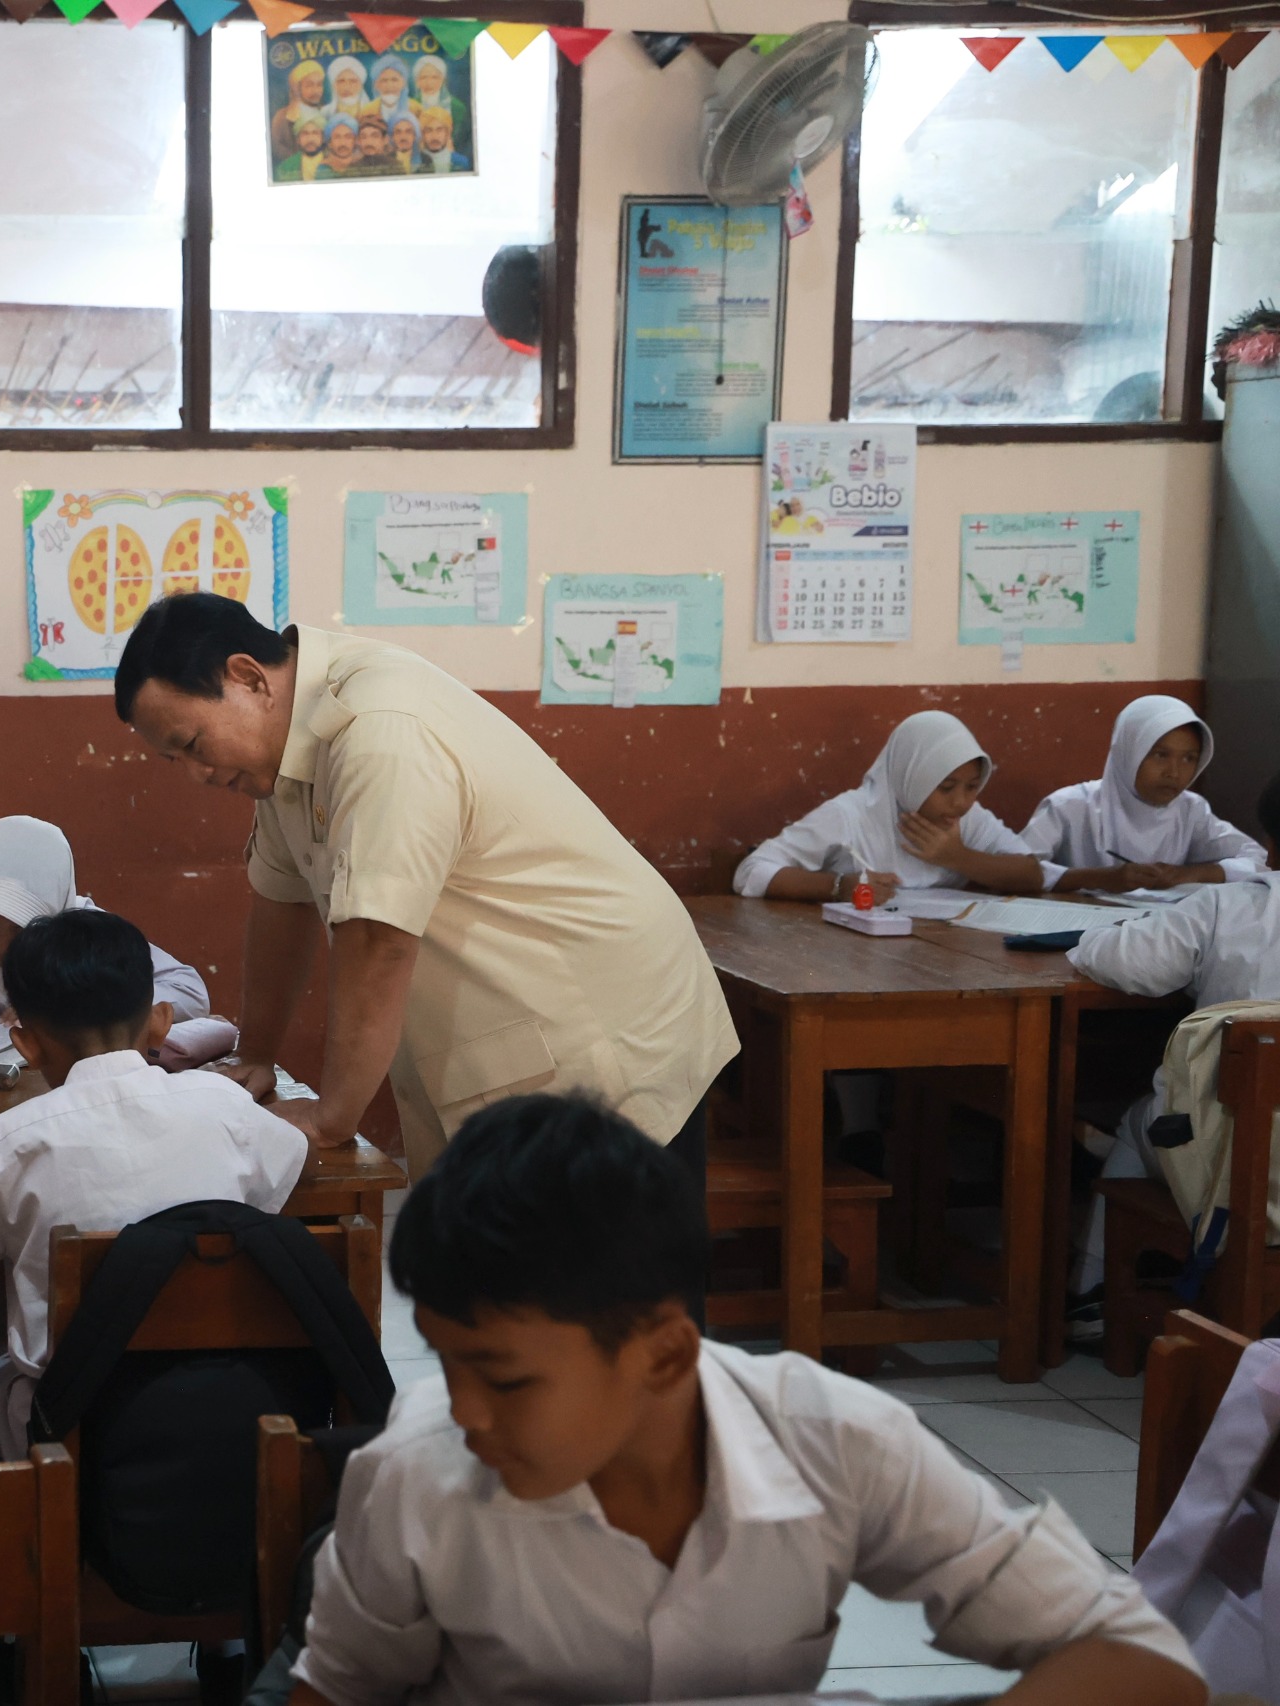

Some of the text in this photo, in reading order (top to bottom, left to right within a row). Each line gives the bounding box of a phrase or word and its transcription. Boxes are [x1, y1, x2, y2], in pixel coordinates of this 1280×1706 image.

[296, 35, 439, 59] WALISNGO
[830, 483, 902, 508] Bebio
[795, 592, 807, 602] 10
[814, 592, 825, 602] 11
[833, 592, 845, 602] 12
[893, 592, 905, 602] 15
[794, 606, 806, 616] 17
[833, 606, 845, 616] 19
[851, 606, 865, 616] 20
[871, 606, 883, 616] 21
[891, 606, 905, 616] 22
[793, 620, 805, 630] 24
[812, 620, 825, 630] 25
[831, 620, 844, 630] 26
[851, 620, 863, 630] 27
